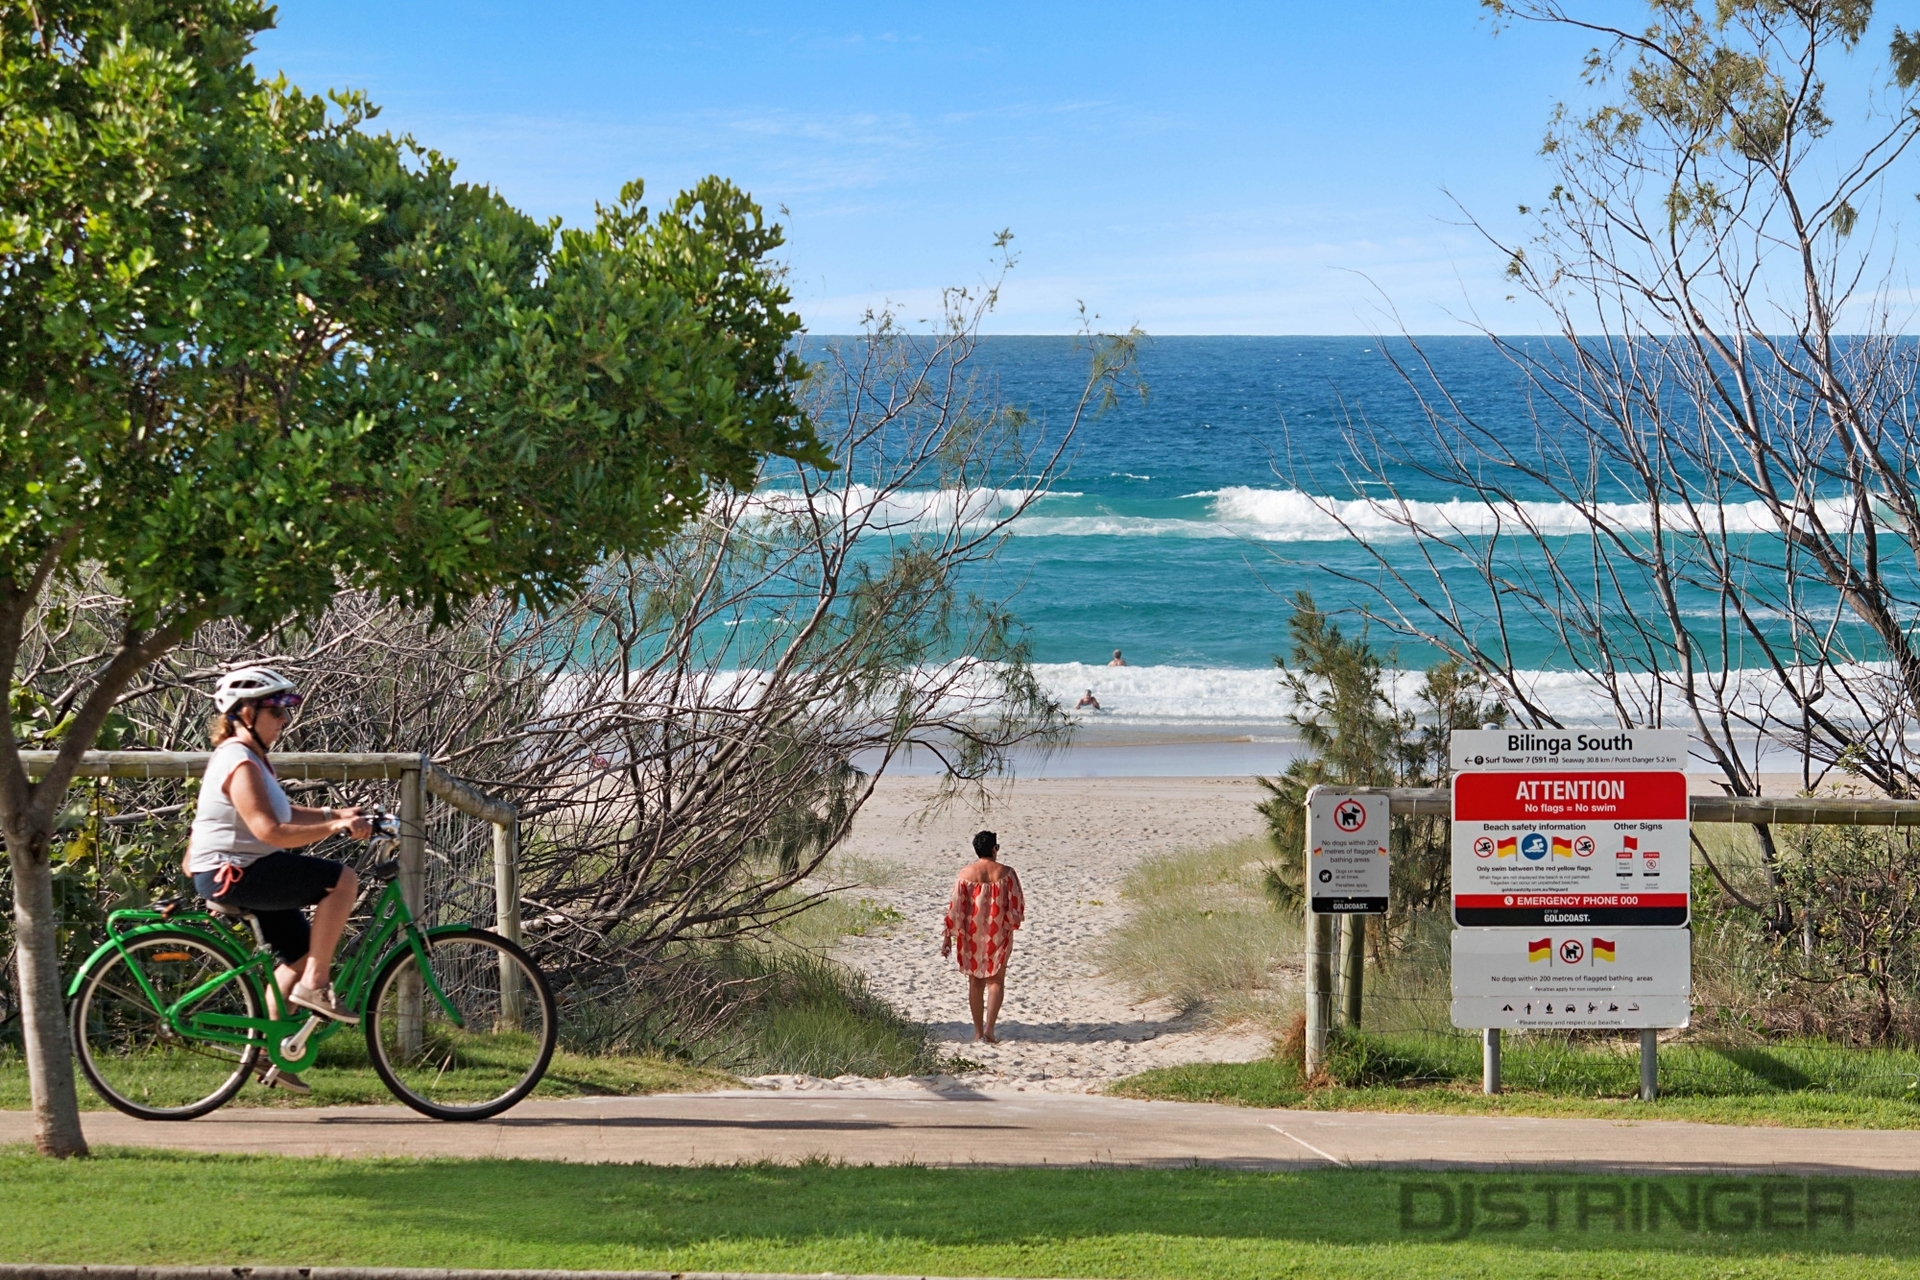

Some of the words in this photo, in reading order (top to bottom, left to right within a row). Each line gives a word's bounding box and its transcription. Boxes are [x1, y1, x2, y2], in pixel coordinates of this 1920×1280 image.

[1508, 734, 1571, 754] Bilinga
[1578, 734, 1632, 750] South
[1516, 780, 1625, 800] ATTENTION
[1525, 804, 1539, 812] No
[1541, 804, 1564, 814] flags
[1575, 804, 1589, 812] No
[1591, 803, 1616, 812] swim
[1512, 824, 1537, 832] safety
[1639, 822, 1663, 831] Signs
[1517, 896, 1581, 906] EMERGENCY
[1583, 896, 1618, 905] PHONE
[1620, 896, 1638, 905] 000
[1544, 914, 1590, 922] GOLDCOAST.
